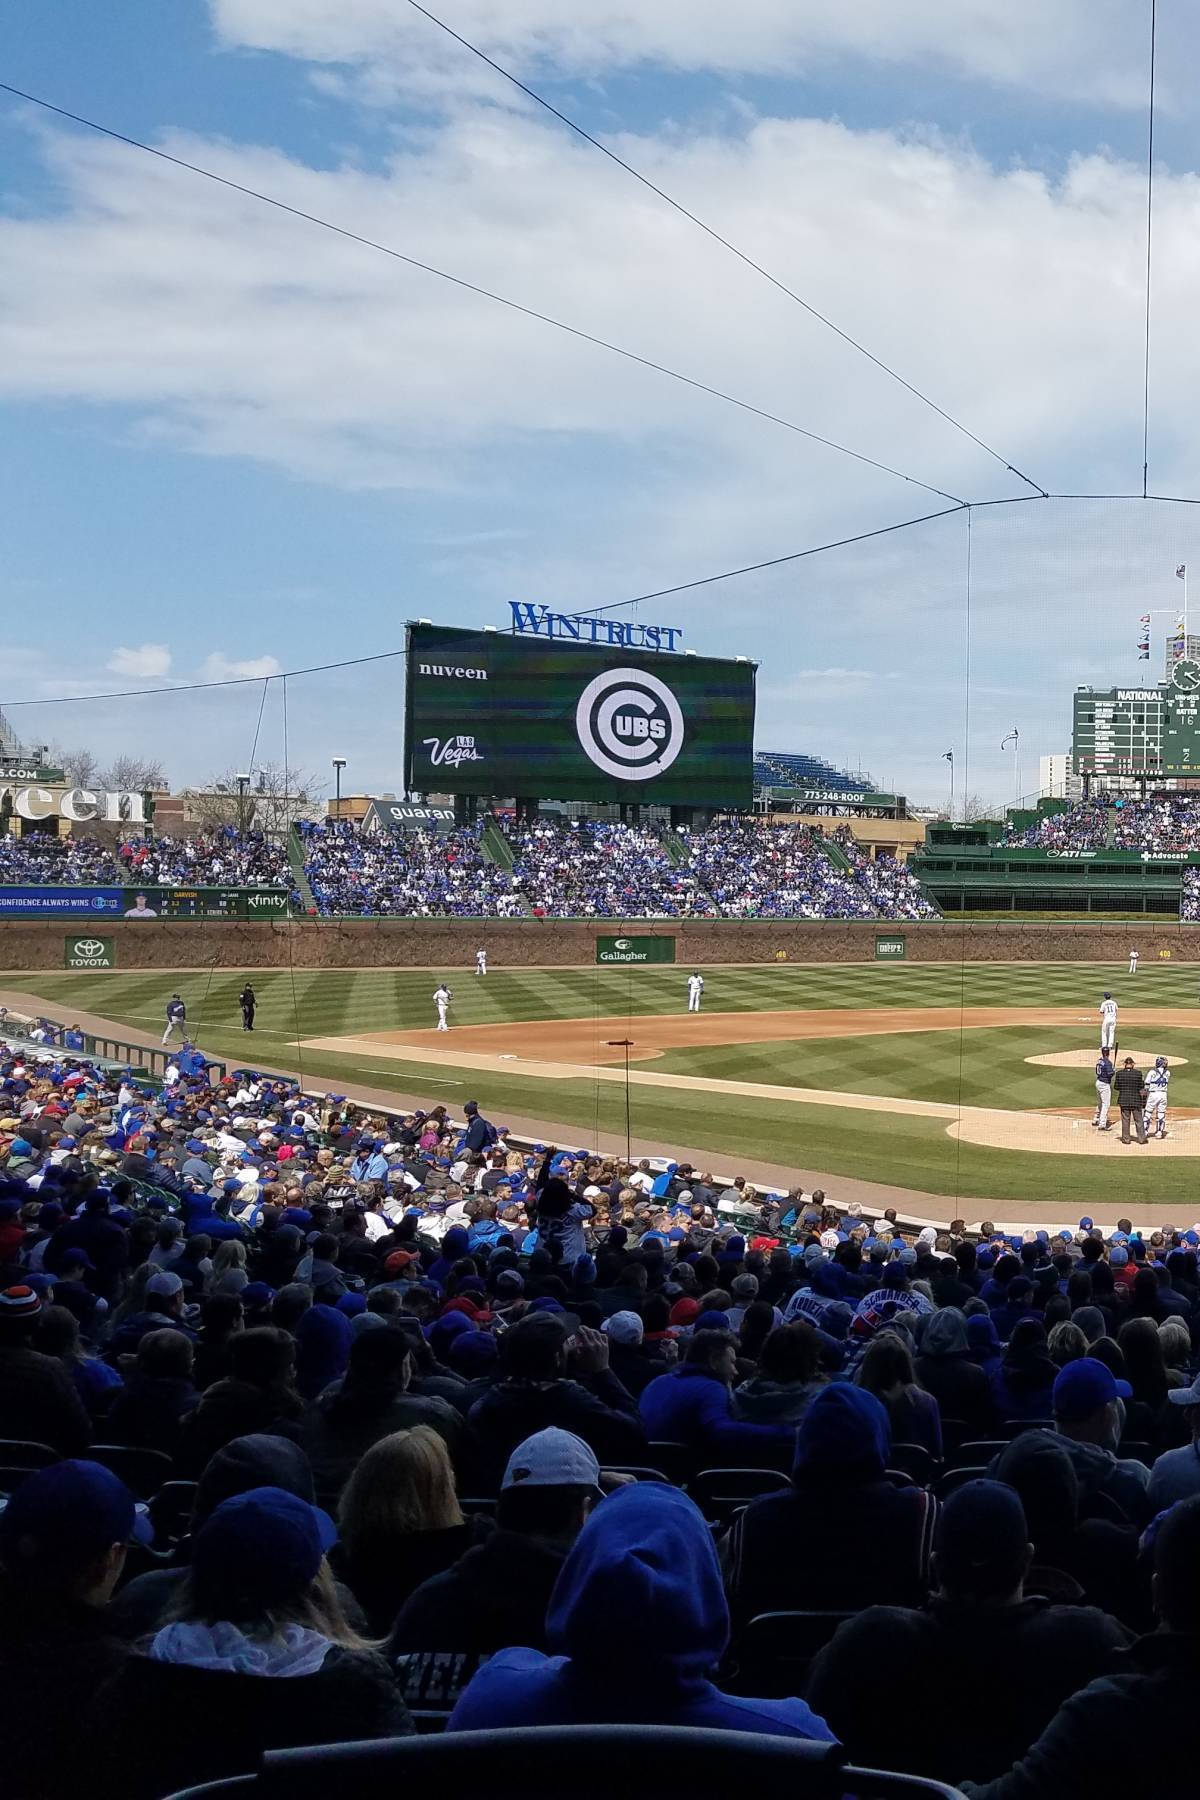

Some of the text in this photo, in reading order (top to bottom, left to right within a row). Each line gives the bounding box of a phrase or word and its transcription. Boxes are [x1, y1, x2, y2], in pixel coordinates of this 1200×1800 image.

[509, 601, 682, 651] WINTRUST
[419, 664, 488, 680] nuveen
[1118, 691, 1164, 701] NATIONAL
[457, 737, 474, 747] LAS
[423, 737, 485, 768] Vegas
[1183, 753, 1190, 761] 2
[804, 790, 865, 802] 773-248-ROOF
[390, 806, 456, 820] guaran
[1060, 850, 1080, 858] ATI
[1152, 852, 1189, 860] Advocate
[247, 894, 287, 908] xfinity
[600, 951, 648, 961] Gallagher
[70, 958, 110, 967] TOYOTA
